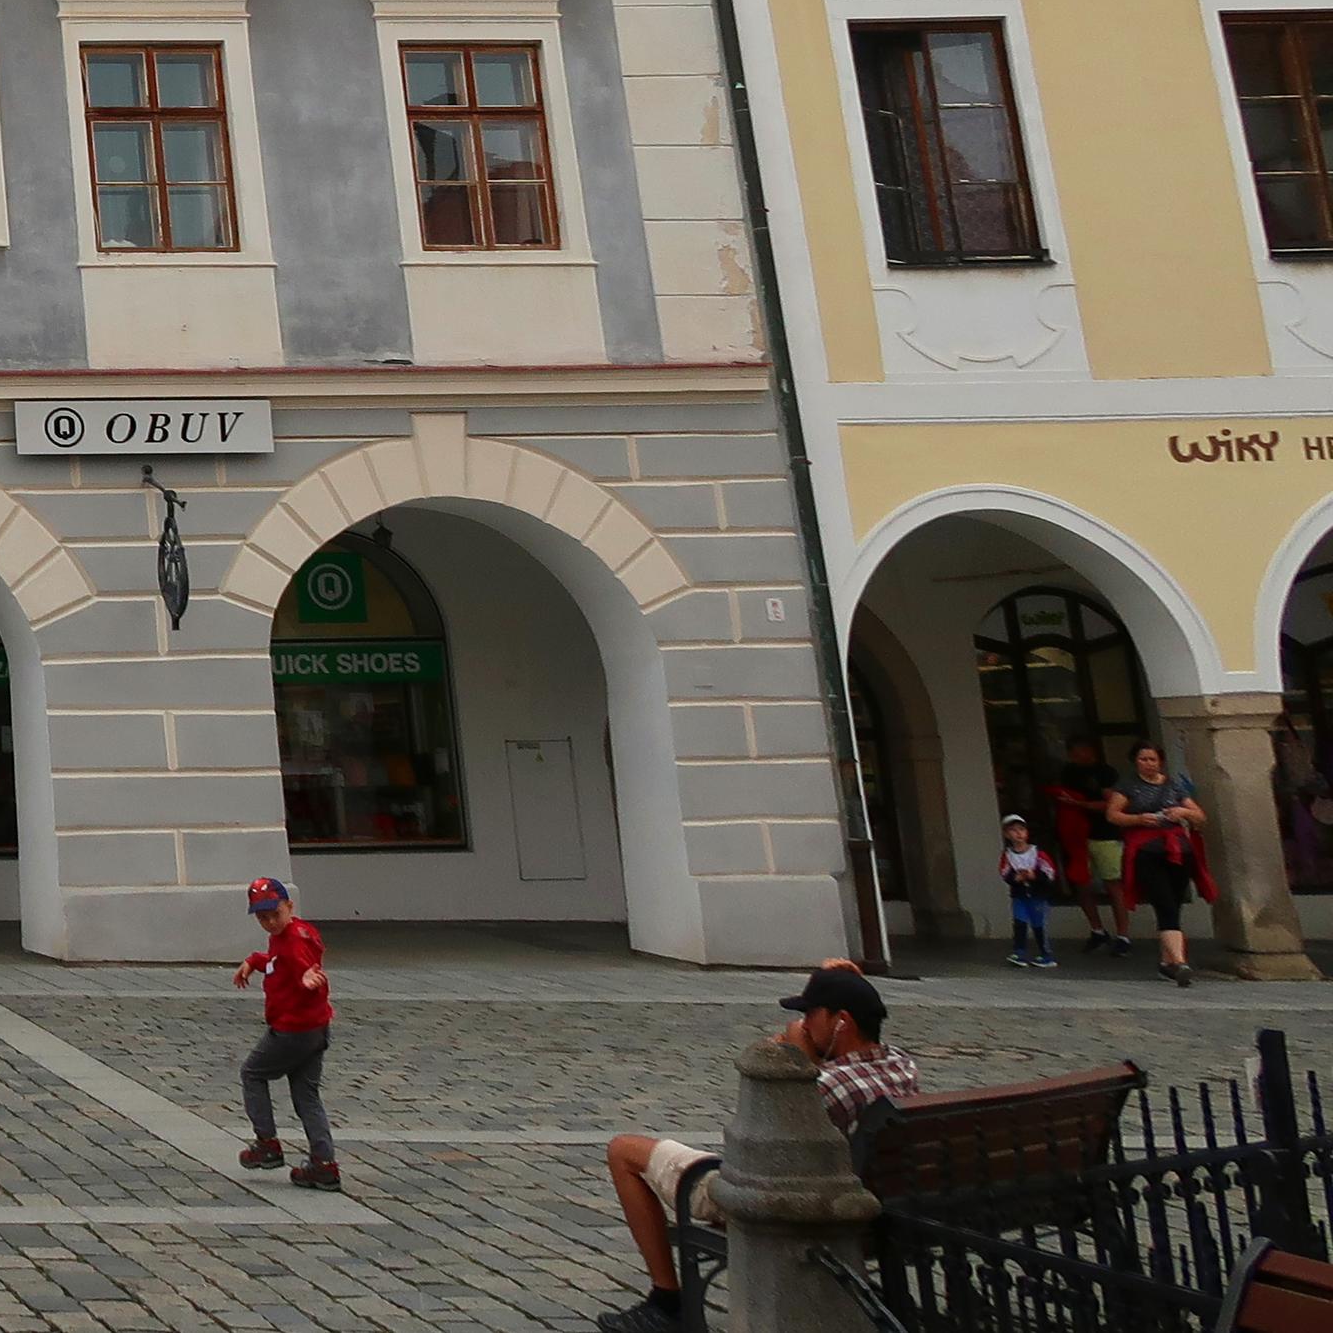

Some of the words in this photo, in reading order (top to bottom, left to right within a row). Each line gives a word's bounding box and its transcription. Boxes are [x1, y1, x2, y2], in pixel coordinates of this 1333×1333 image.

[105, 411, 245, 444] OBUV
[271, 653, 330, 675] UICK
[336, 652, 421, 674] SHOES
